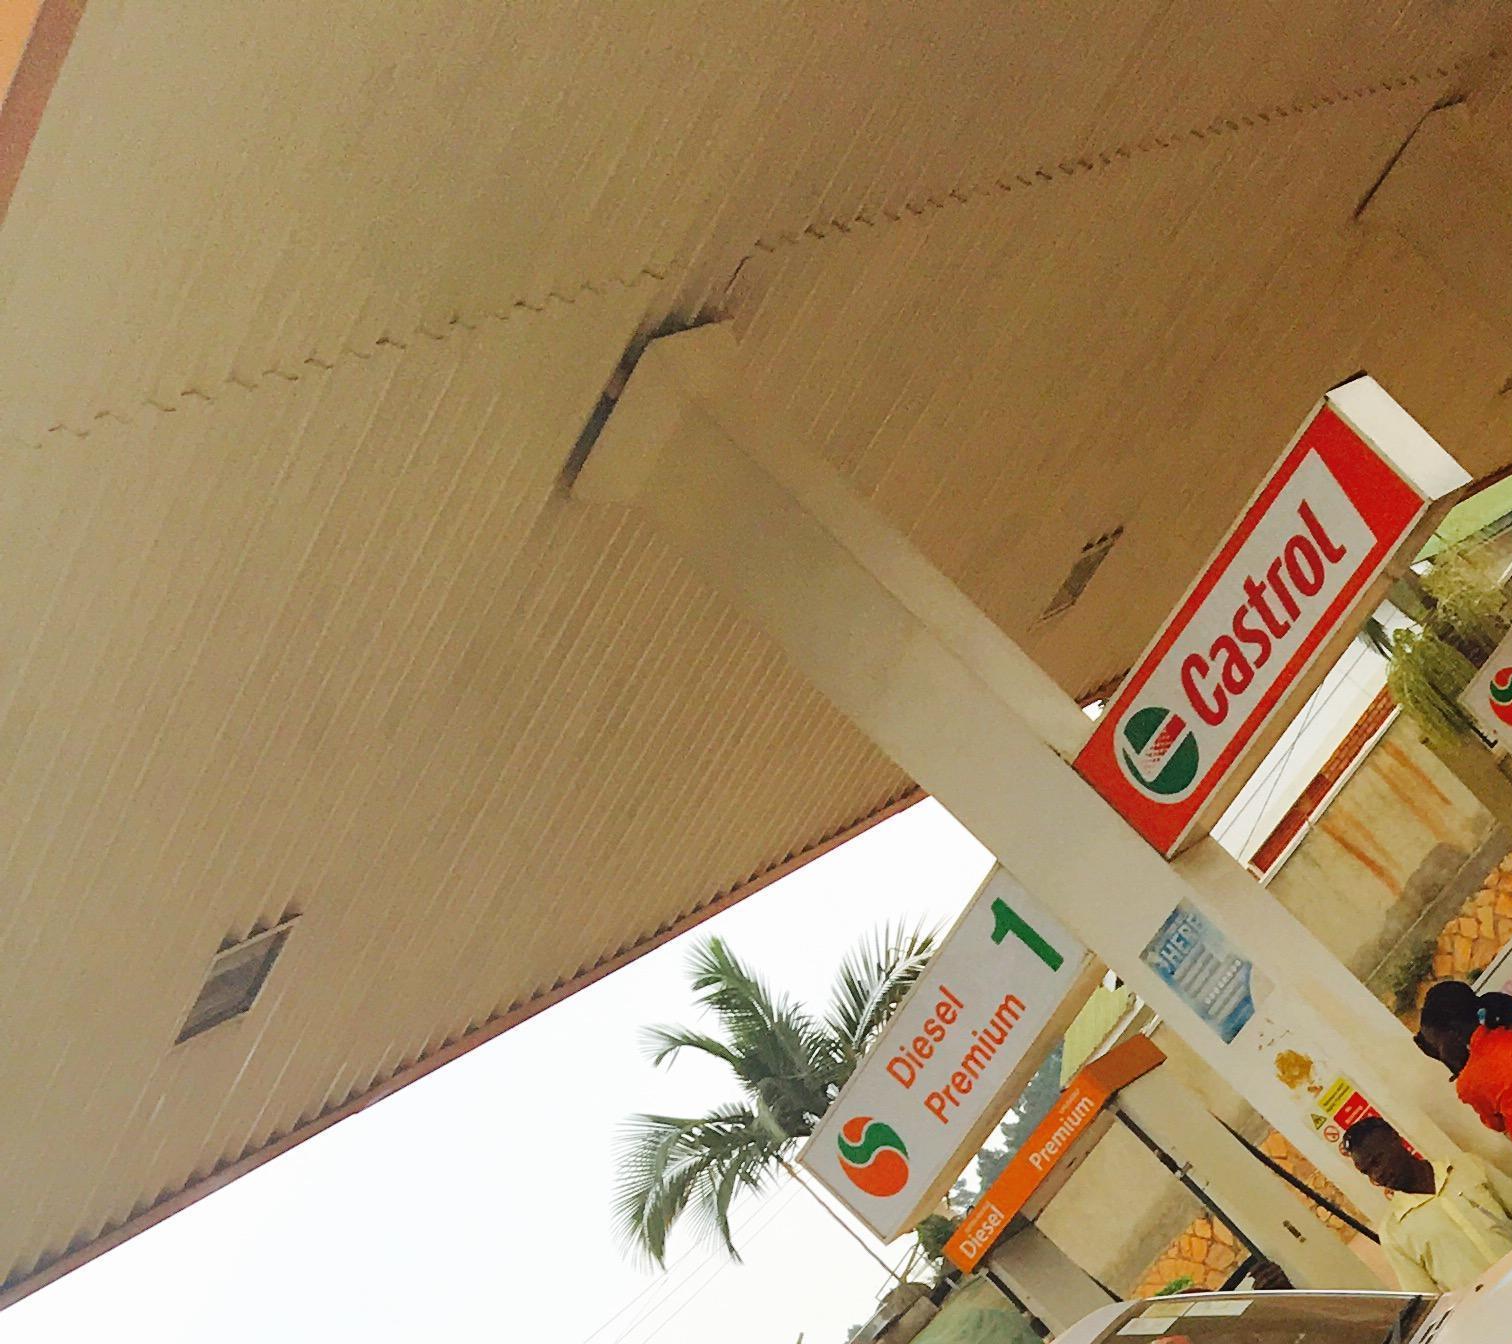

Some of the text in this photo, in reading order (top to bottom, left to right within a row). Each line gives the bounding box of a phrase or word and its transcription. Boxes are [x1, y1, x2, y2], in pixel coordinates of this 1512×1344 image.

[1181, 498, 1348, 727] Castrol
[990, 896, 1064, 973] 1
[885, 984, 965, 1090] Diesel
[923, 993, 1027, 1124] Premium
[959, 1203, 1006, 1260] Diesel
[1028, 1095, 1097, 1171] Premium
